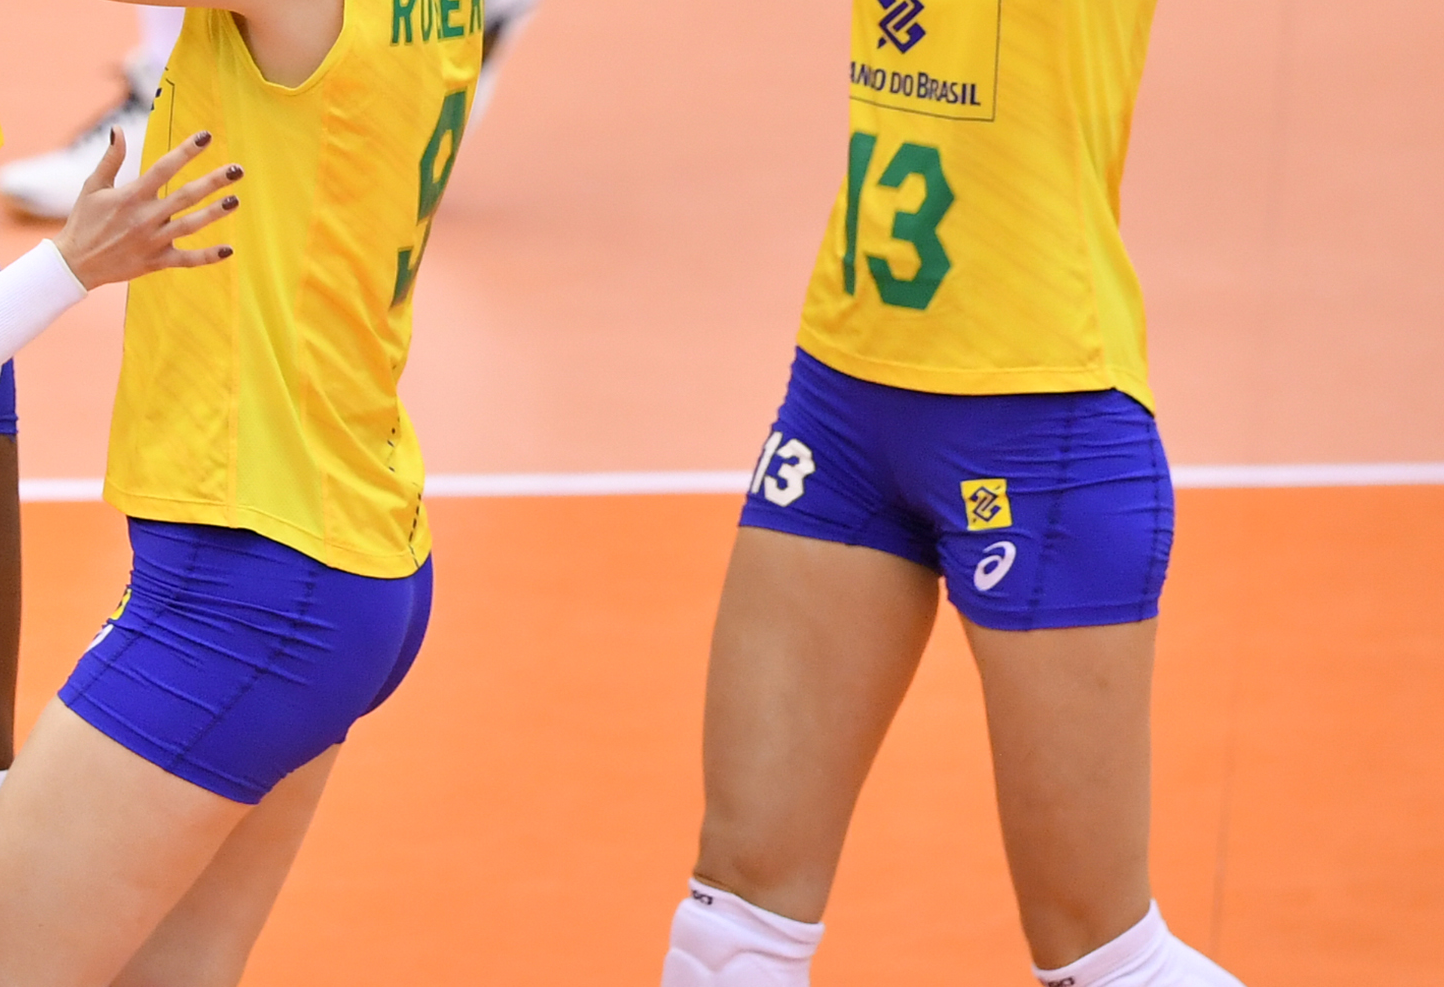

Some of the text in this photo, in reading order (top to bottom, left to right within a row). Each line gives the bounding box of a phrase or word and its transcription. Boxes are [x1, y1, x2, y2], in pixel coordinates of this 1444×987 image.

[889, 71, 914, 96] DO
[917, 72, 982, 107] BRASIL
[842, 130, 956, 311] 13
[750, 430, 816, 508] 13
